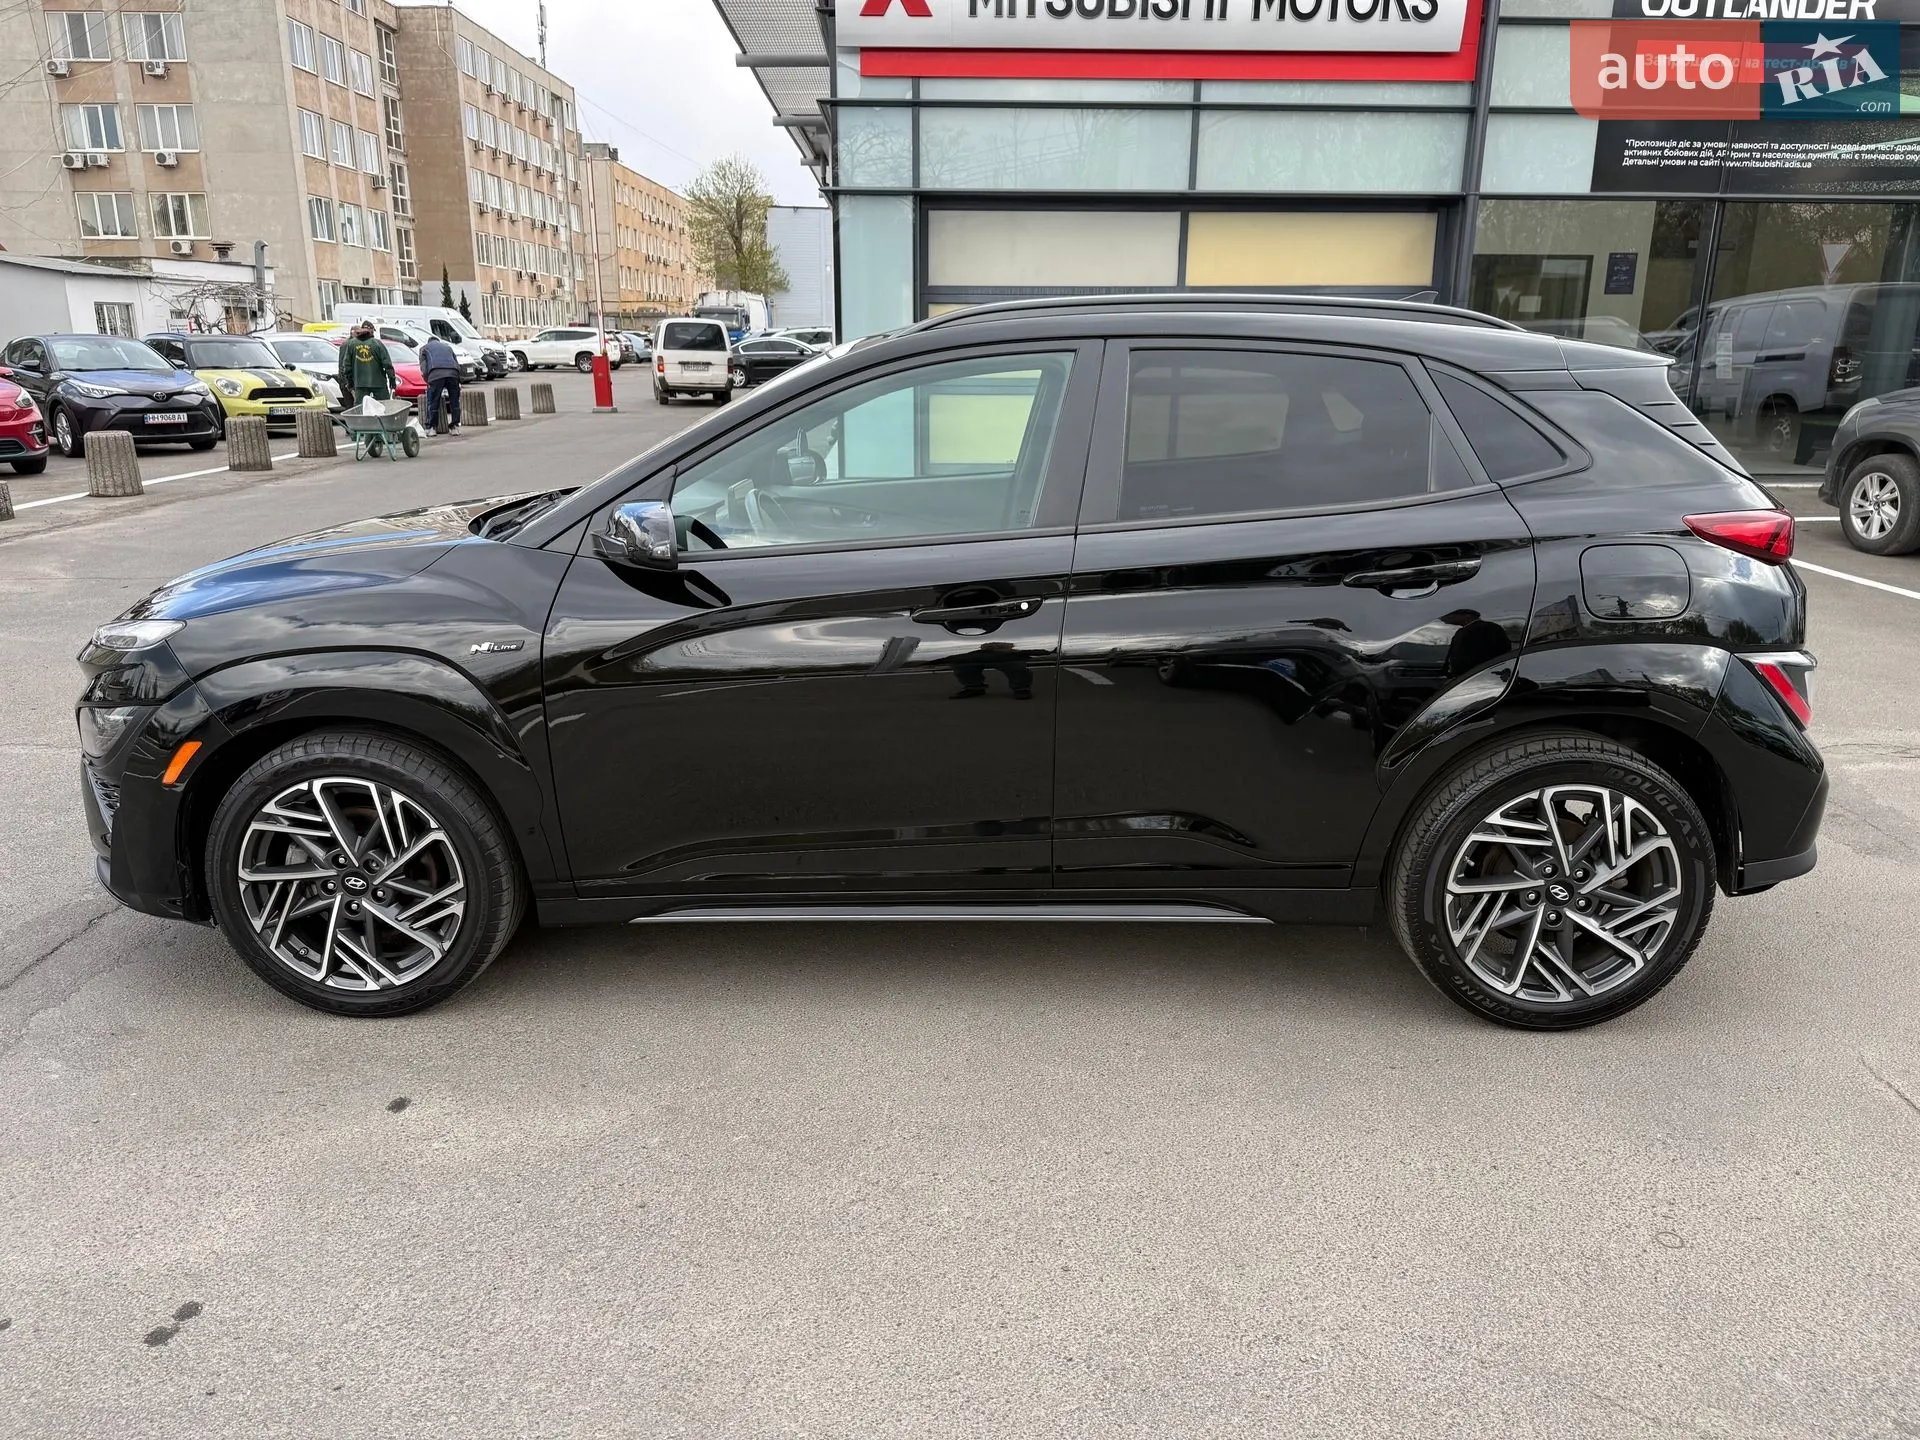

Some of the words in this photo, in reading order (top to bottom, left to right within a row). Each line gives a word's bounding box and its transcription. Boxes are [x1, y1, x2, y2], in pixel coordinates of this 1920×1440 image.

[1678, 140, 1690, 148] діє
[1702, 141, 1729, 149] умови
[1780, 142, 1830, 151] доступності
[1831, 142, 1860, 151] моделі
[1663, 149, 1698, 157] бойових
[1699, 149, 1714, 157] дій,
[1807, 152, 1840, 160] пунктів,
[1841, 152, 1853, 160] які
[1622, 157, 1659, 166] Детальні
[1660, 159, 1687, 167] умови
[1699, 158, 1720, 166] сайті
